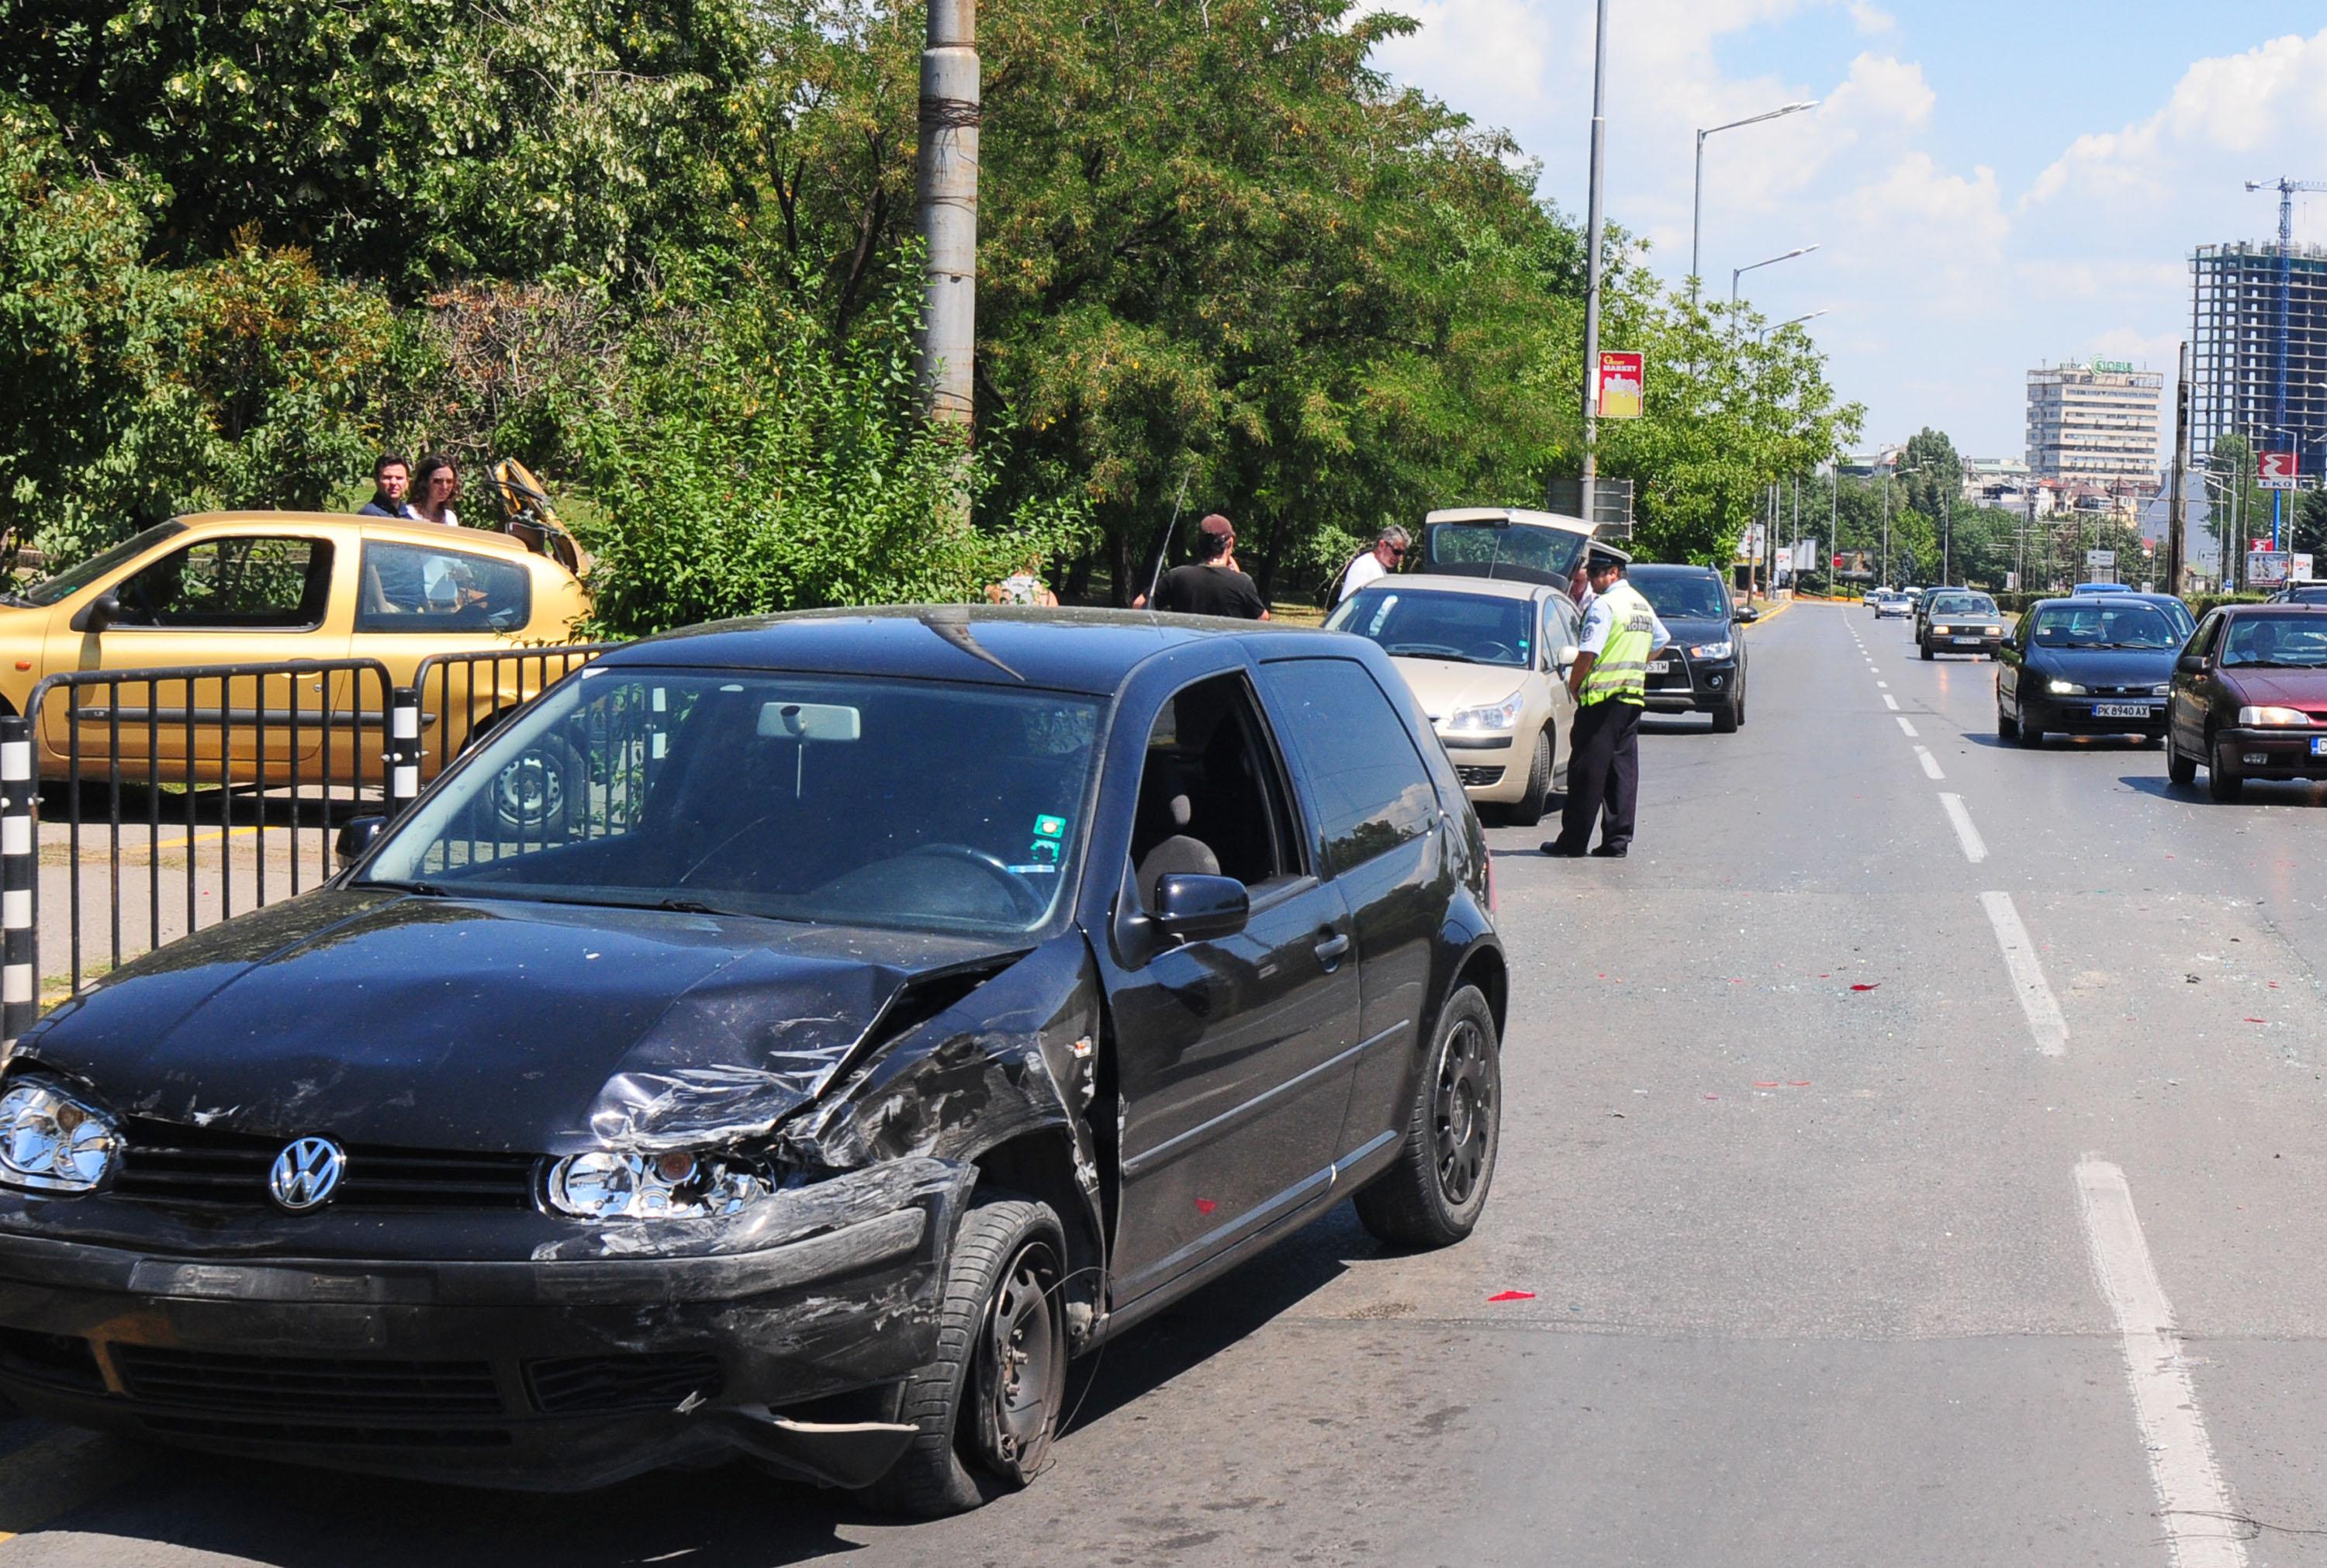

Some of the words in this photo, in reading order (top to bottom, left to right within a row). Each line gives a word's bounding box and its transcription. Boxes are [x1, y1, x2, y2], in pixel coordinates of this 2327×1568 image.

[2097, 706, 2110, 715] PK
[2111, 706, 2135, 716] 8940
[2135, 706, 2148, 717] AX
